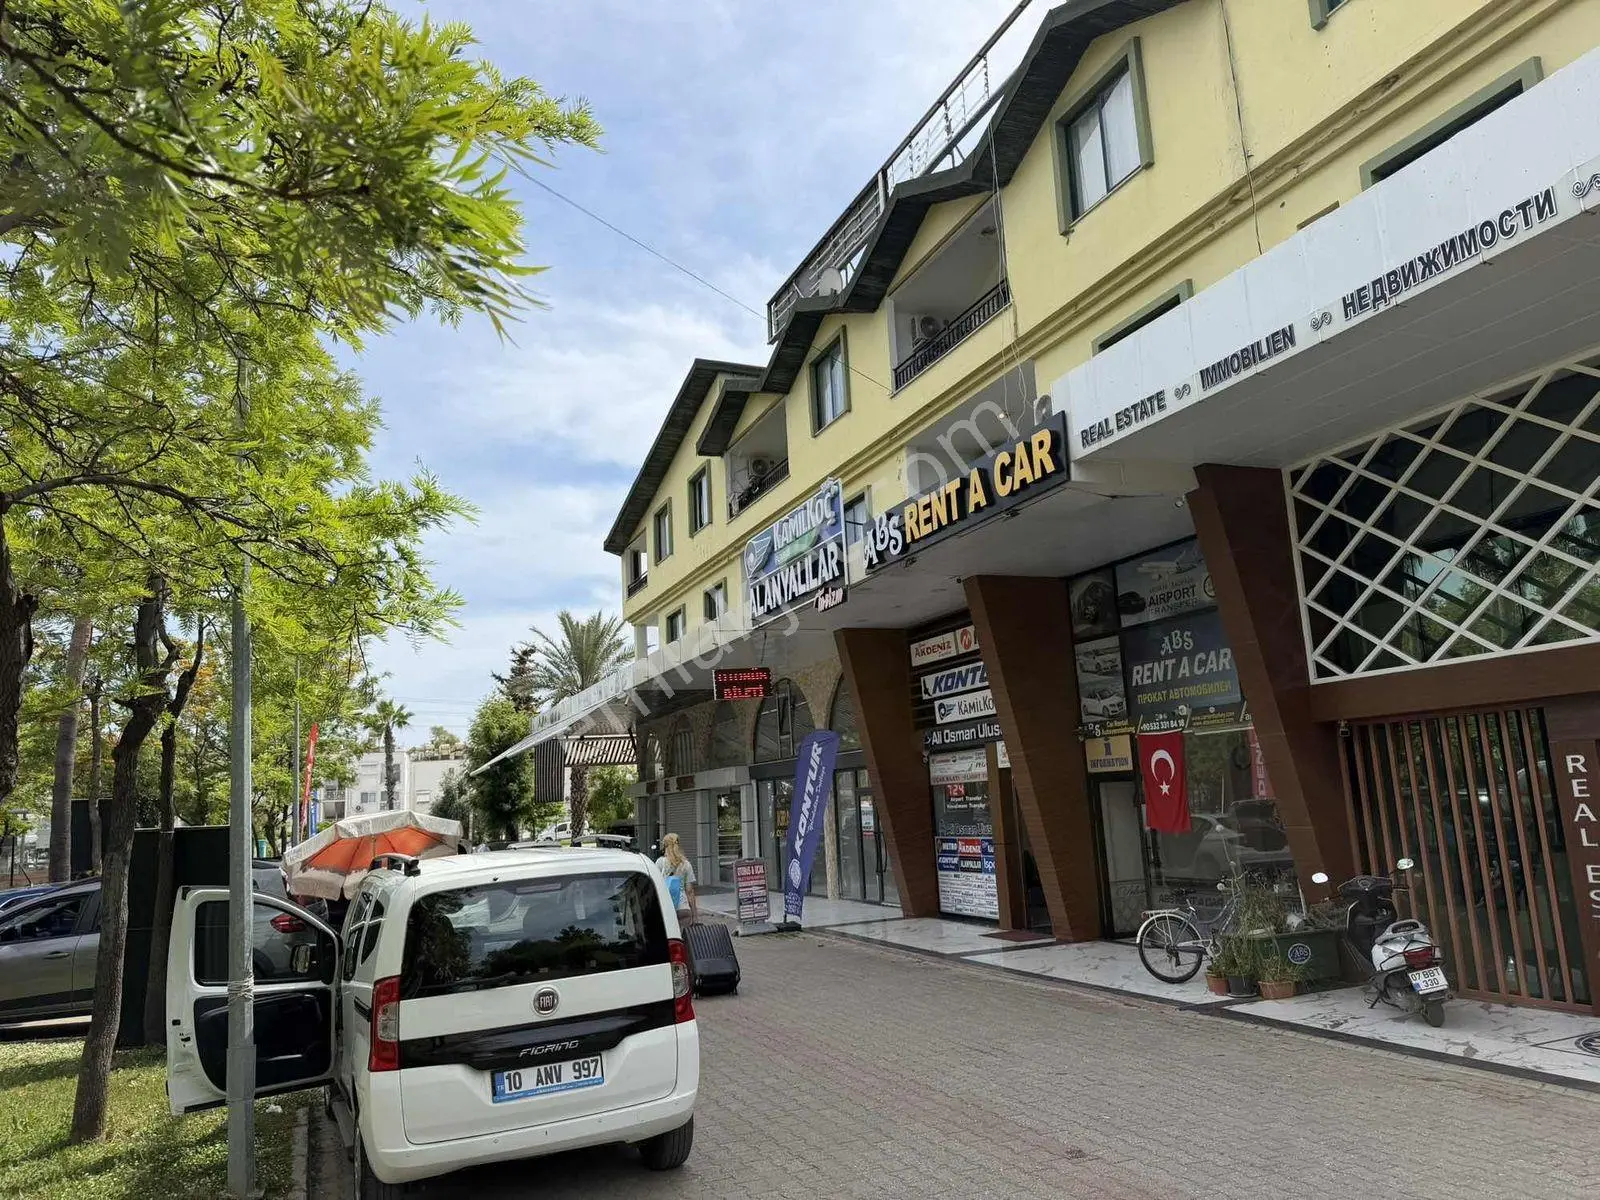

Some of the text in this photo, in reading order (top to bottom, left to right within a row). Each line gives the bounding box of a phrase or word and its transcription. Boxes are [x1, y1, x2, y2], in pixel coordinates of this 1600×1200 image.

[1341, 185, 1557, 320] НЕДВИЖИМОСТИ
[1199, 323, 1297, 392] IMMOBILIEN
[1081, 389, 1167, 449] REAL ESTATE
[863, 428, 1056, 569] ABS RENT A CAR
[750, 542, 840, 618] ALANYALILAR
[1160, 630, 1194, 656] ABS
[1132, 648, 1232, 687] RENT A CAR
[1137, 690, 1167, 705] ПРОКАТ
[931, 722, 1003, 746] Ali Osman Ulus
[1090, 755, 1130, 769] INFORMATION
[794, 741, 823, 857] KONTUR
[1565, 754, 1599, 847] REAL
[1410, 968, 1440, 982] 07 BBT
[1422, 978, 1440, 988] 330
[540, 996, 554, 1008] FIAT
[519, 1039, 580, 1058] FIORINO
[505, 1071, 523, 1092] 10
[536, 1064, 562, 1087] ANV
[572, 1058, 600, 1080] 997
